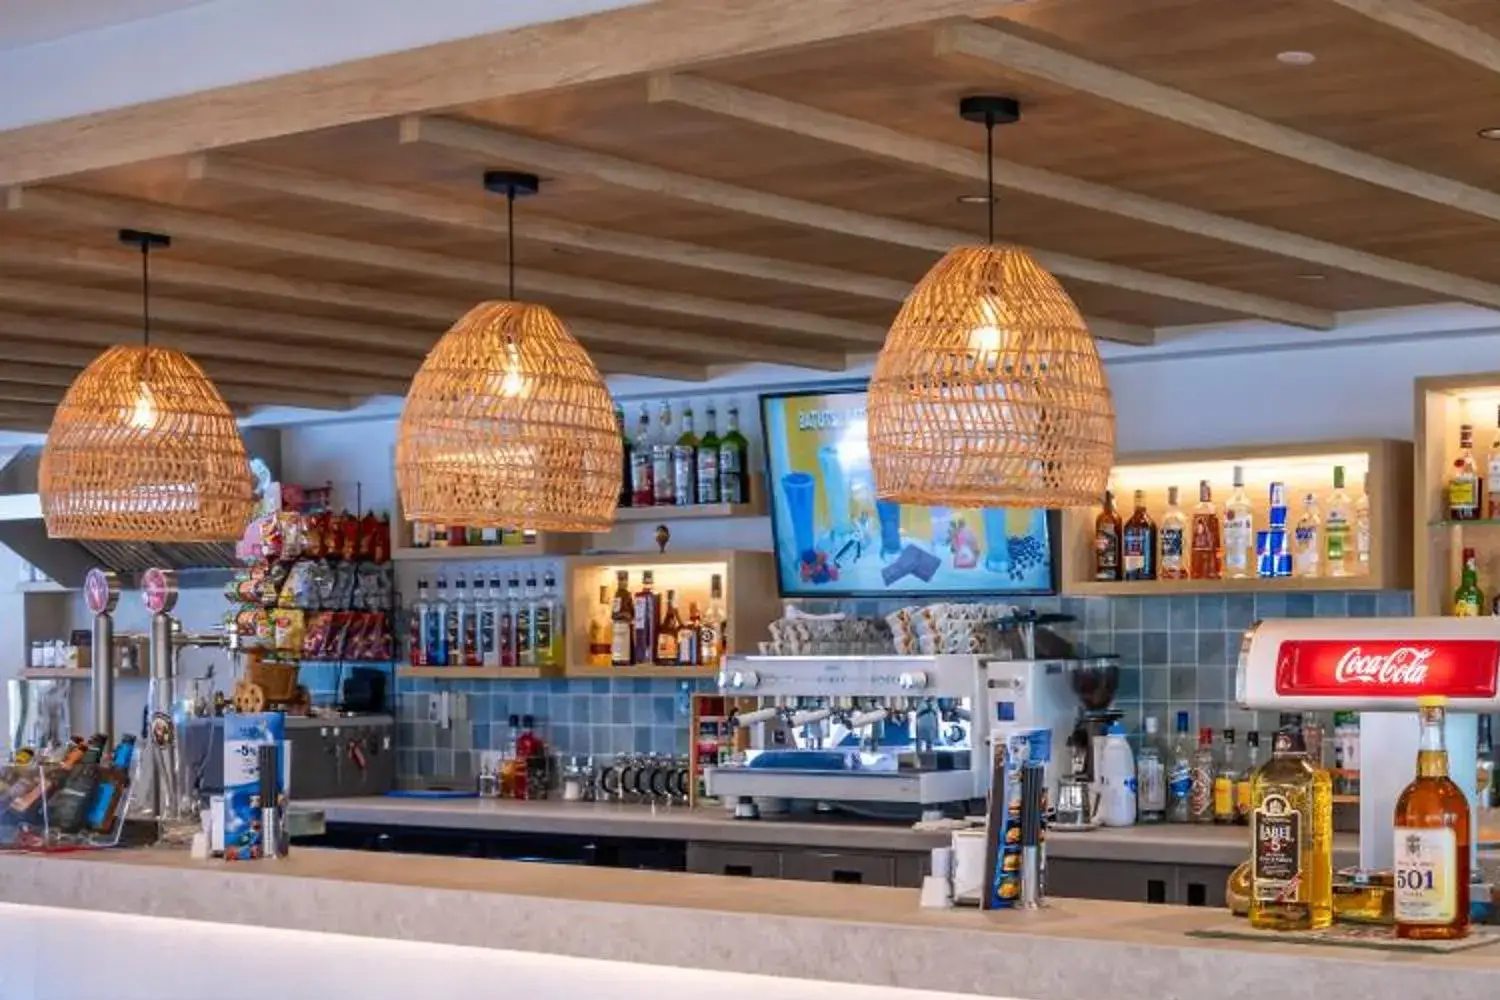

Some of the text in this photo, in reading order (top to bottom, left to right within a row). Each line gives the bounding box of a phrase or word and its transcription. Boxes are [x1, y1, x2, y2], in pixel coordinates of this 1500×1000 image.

[1335, 647, 1435, 684] Coca-Cola
[1259, 825, 1292, 841] LABEL
[1397, 869, 1434, 890] 501
